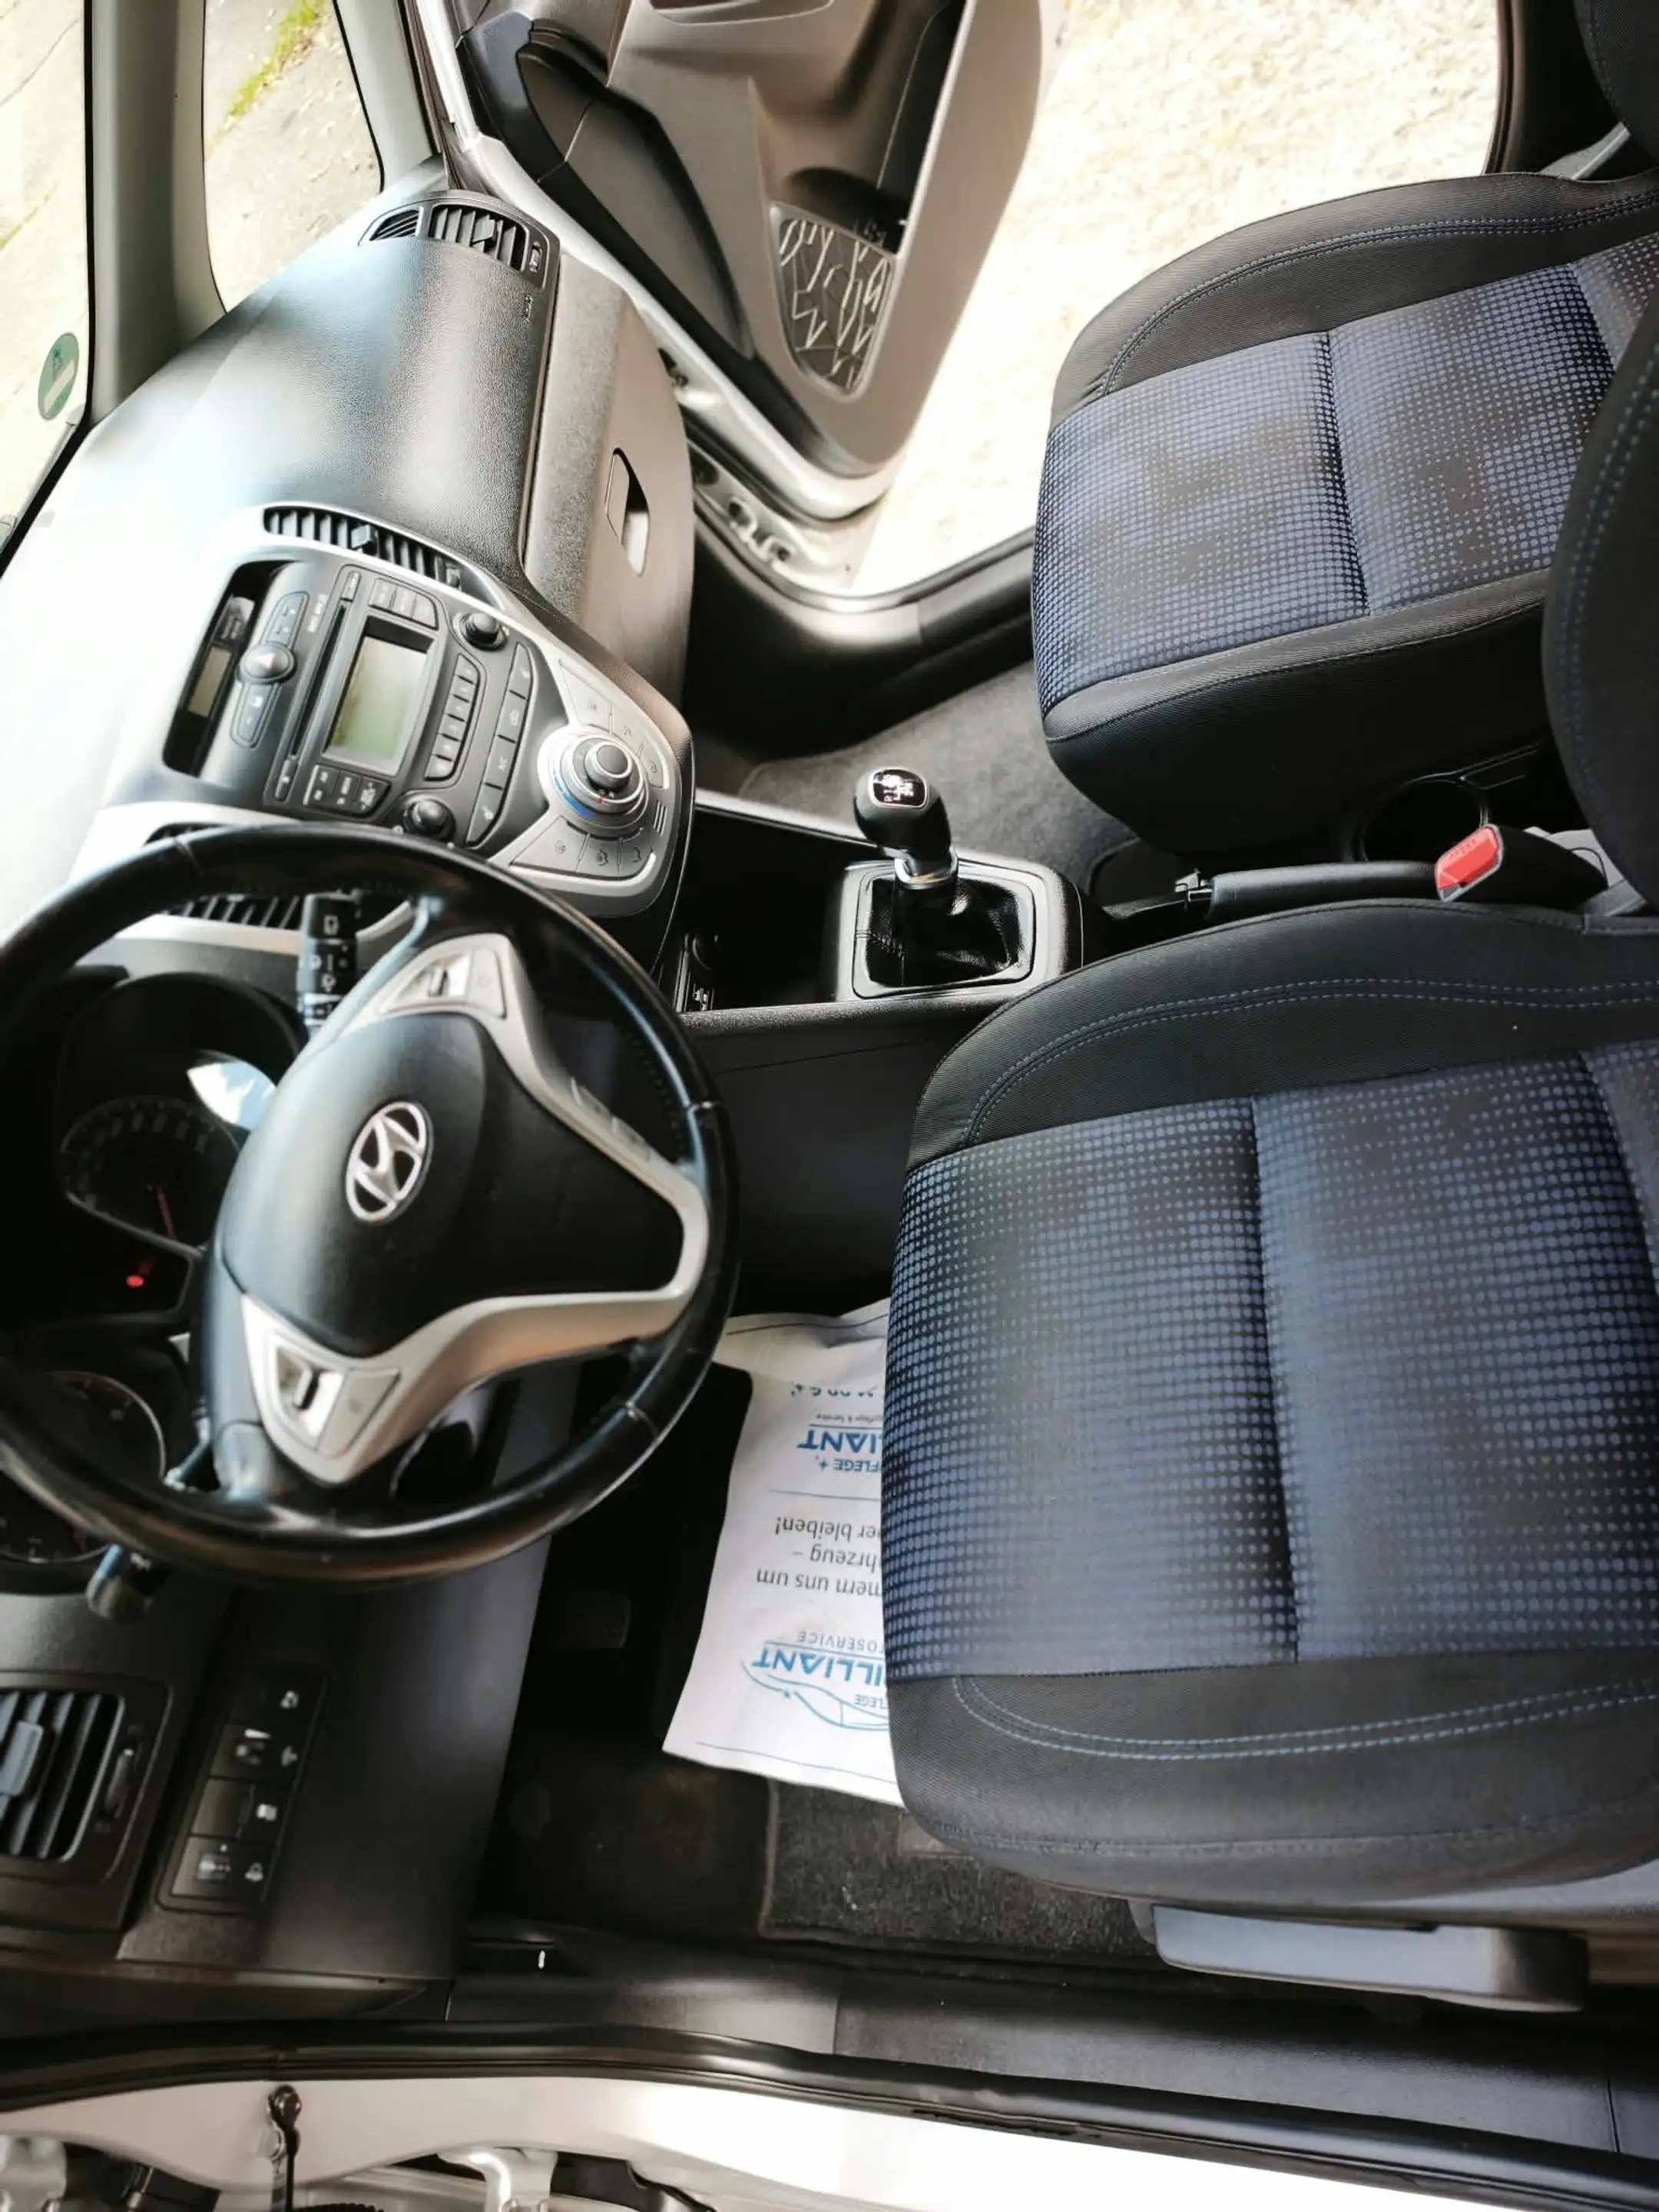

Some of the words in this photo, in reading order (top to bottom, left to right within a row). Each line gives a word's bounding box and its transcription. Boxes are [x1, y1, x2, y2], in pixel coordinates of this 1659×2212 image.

[796, 1429, 881, 1454] IANT
[833, 1459, 881, 1472] FLEGE
[775, 1517, 853, 1542] bleiben!
[856, 1525, 881, 1539] er
[809, 1544, 881, 1574] hrzeug
[756, 1568, 789, 1587] um
[794, 1574, 830, 1591] uns
[751, 1646, 884, 1687] ILLIANT
[854, 1694, 888, 1710] LEGE
